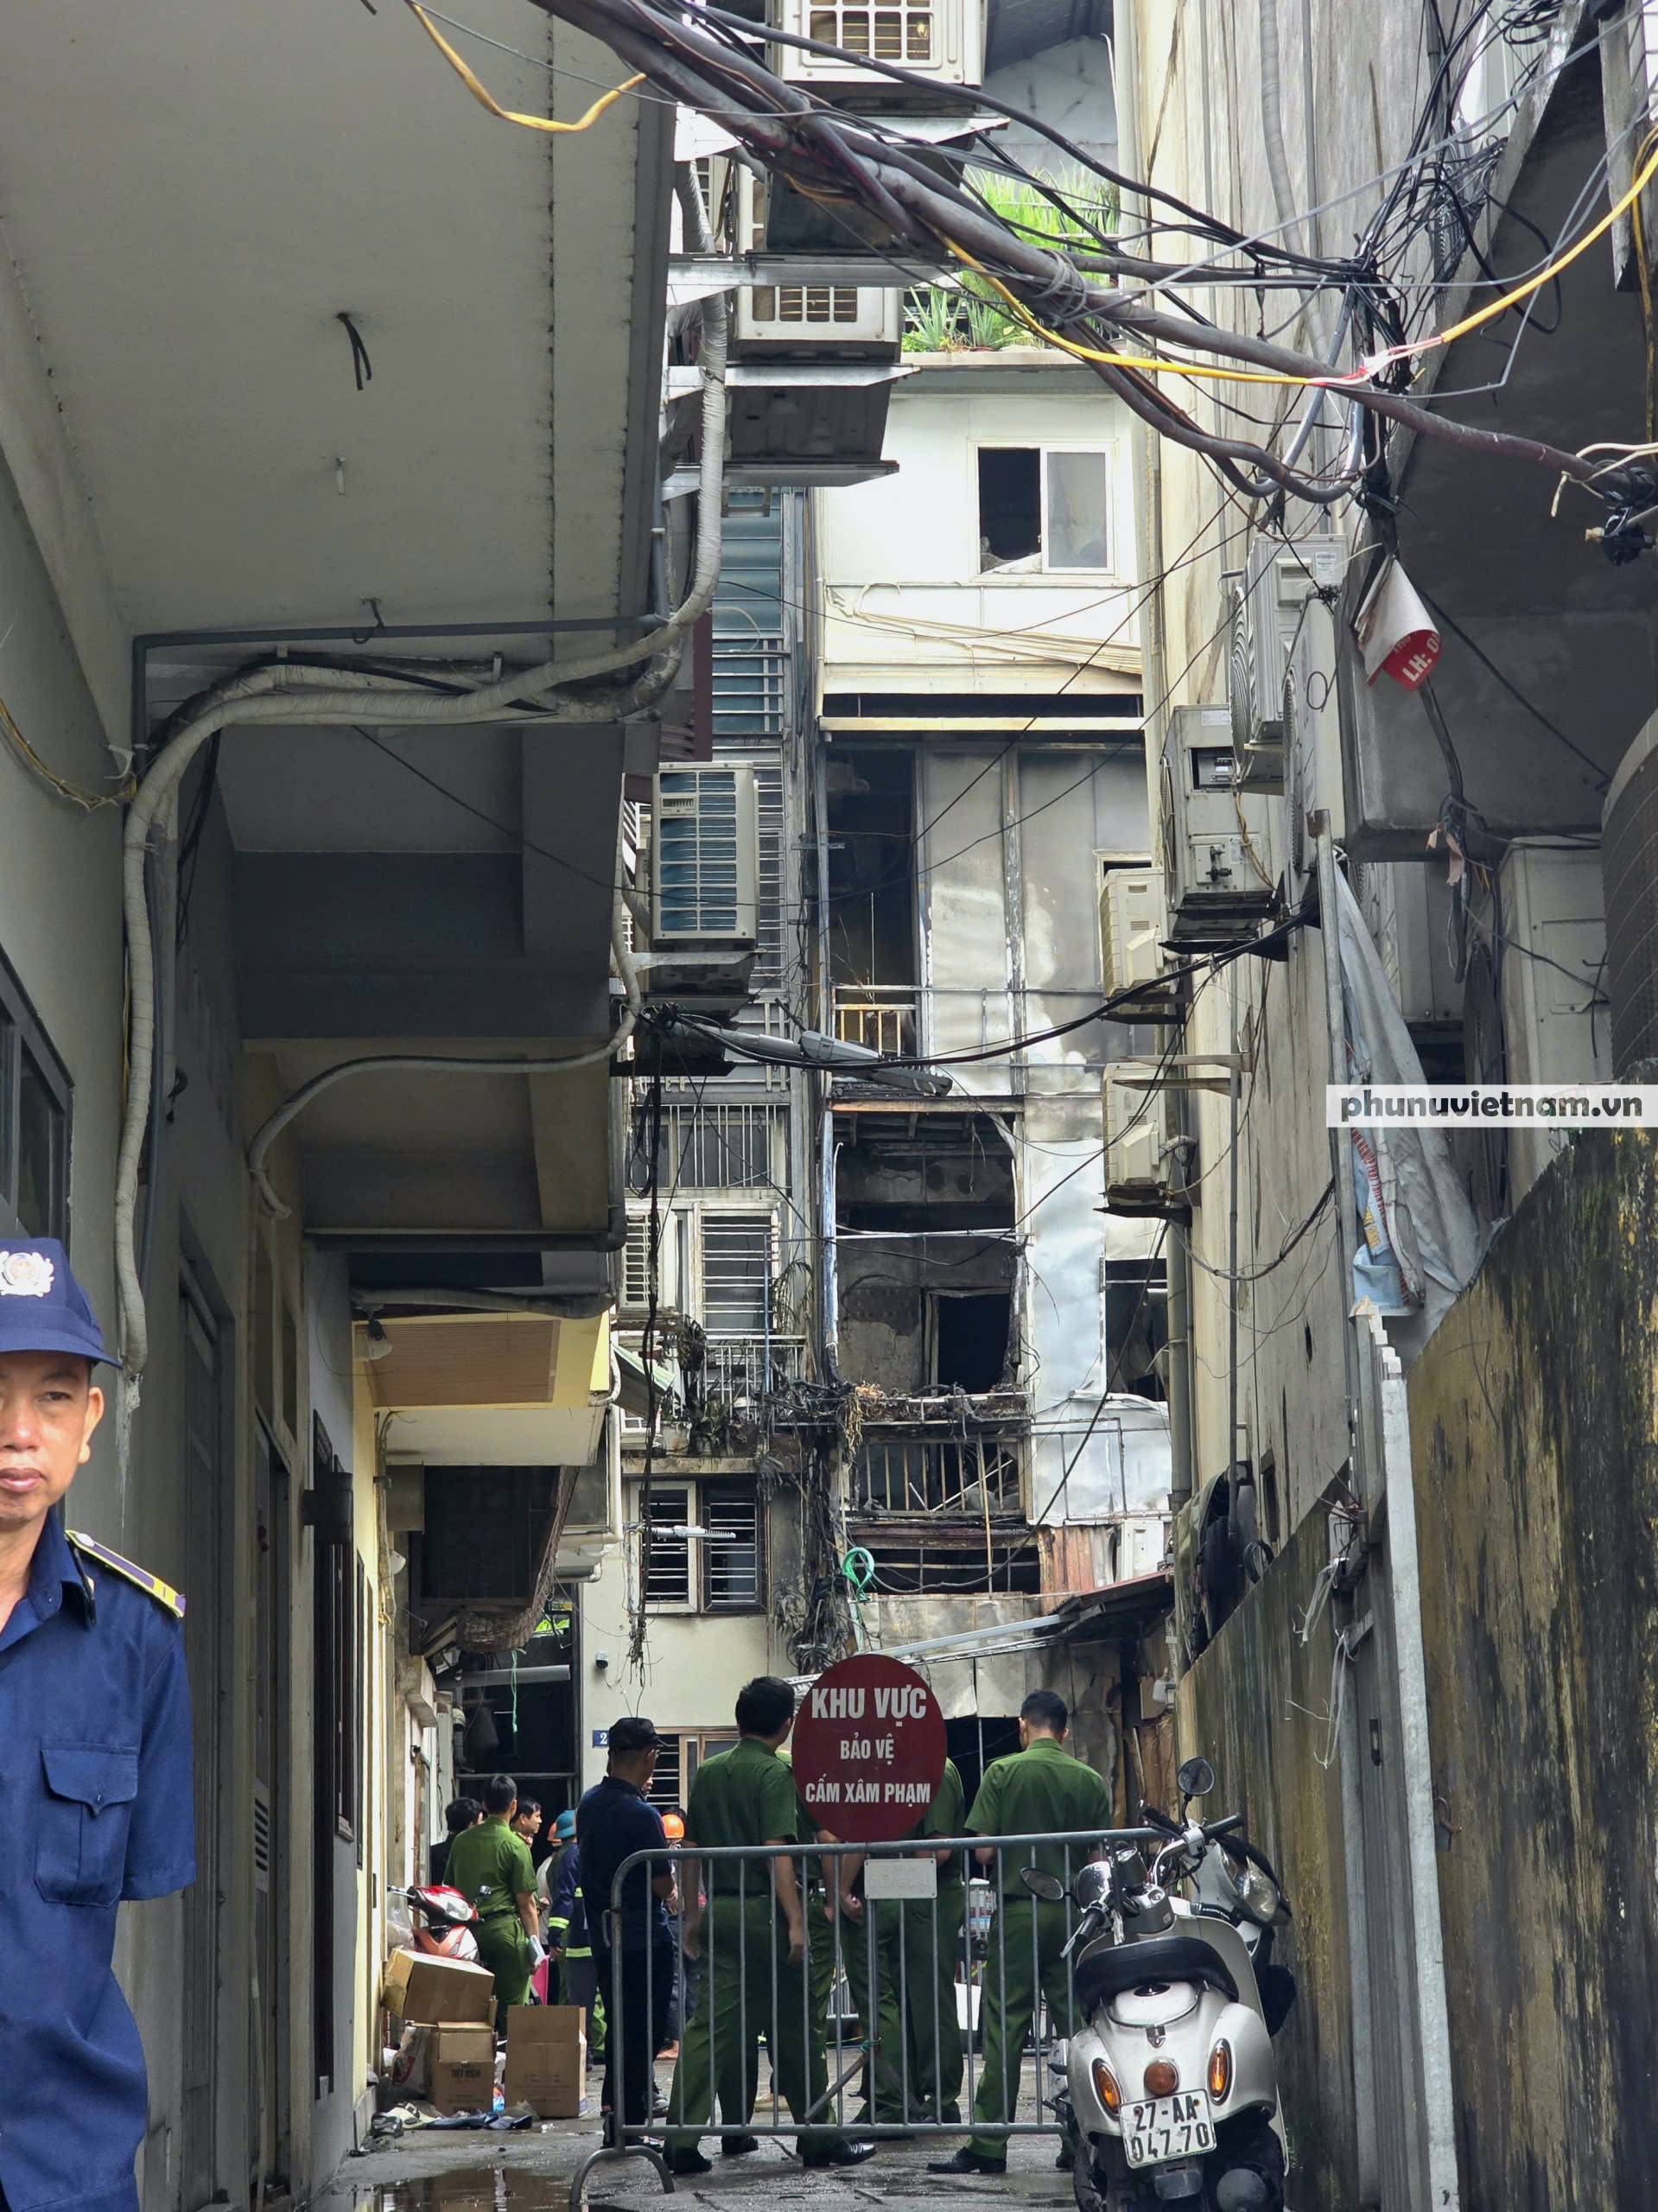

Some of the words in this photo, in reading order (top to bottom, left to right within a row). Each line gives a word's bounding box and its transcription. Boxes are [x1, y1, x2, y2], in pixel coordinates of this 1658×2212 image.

[1402, 653, 1432, 682] LH:
[811, 1687, 865, 1719] KHU
[874, 1685, 927, 1727] VỰC
[841, 1732, 871, 1759] BẢO
[875, 1733, 894, 1765] VỆ
[805, 1773, 840, 1803] CẤM
[844, 1779, 880, 1803] XÂM
[885, 1783, 931, 1808] PHẠM
[1134, 2095, 1197, 2132] 27-AA
[1131, 2122, 1210, 2163] 047.70
